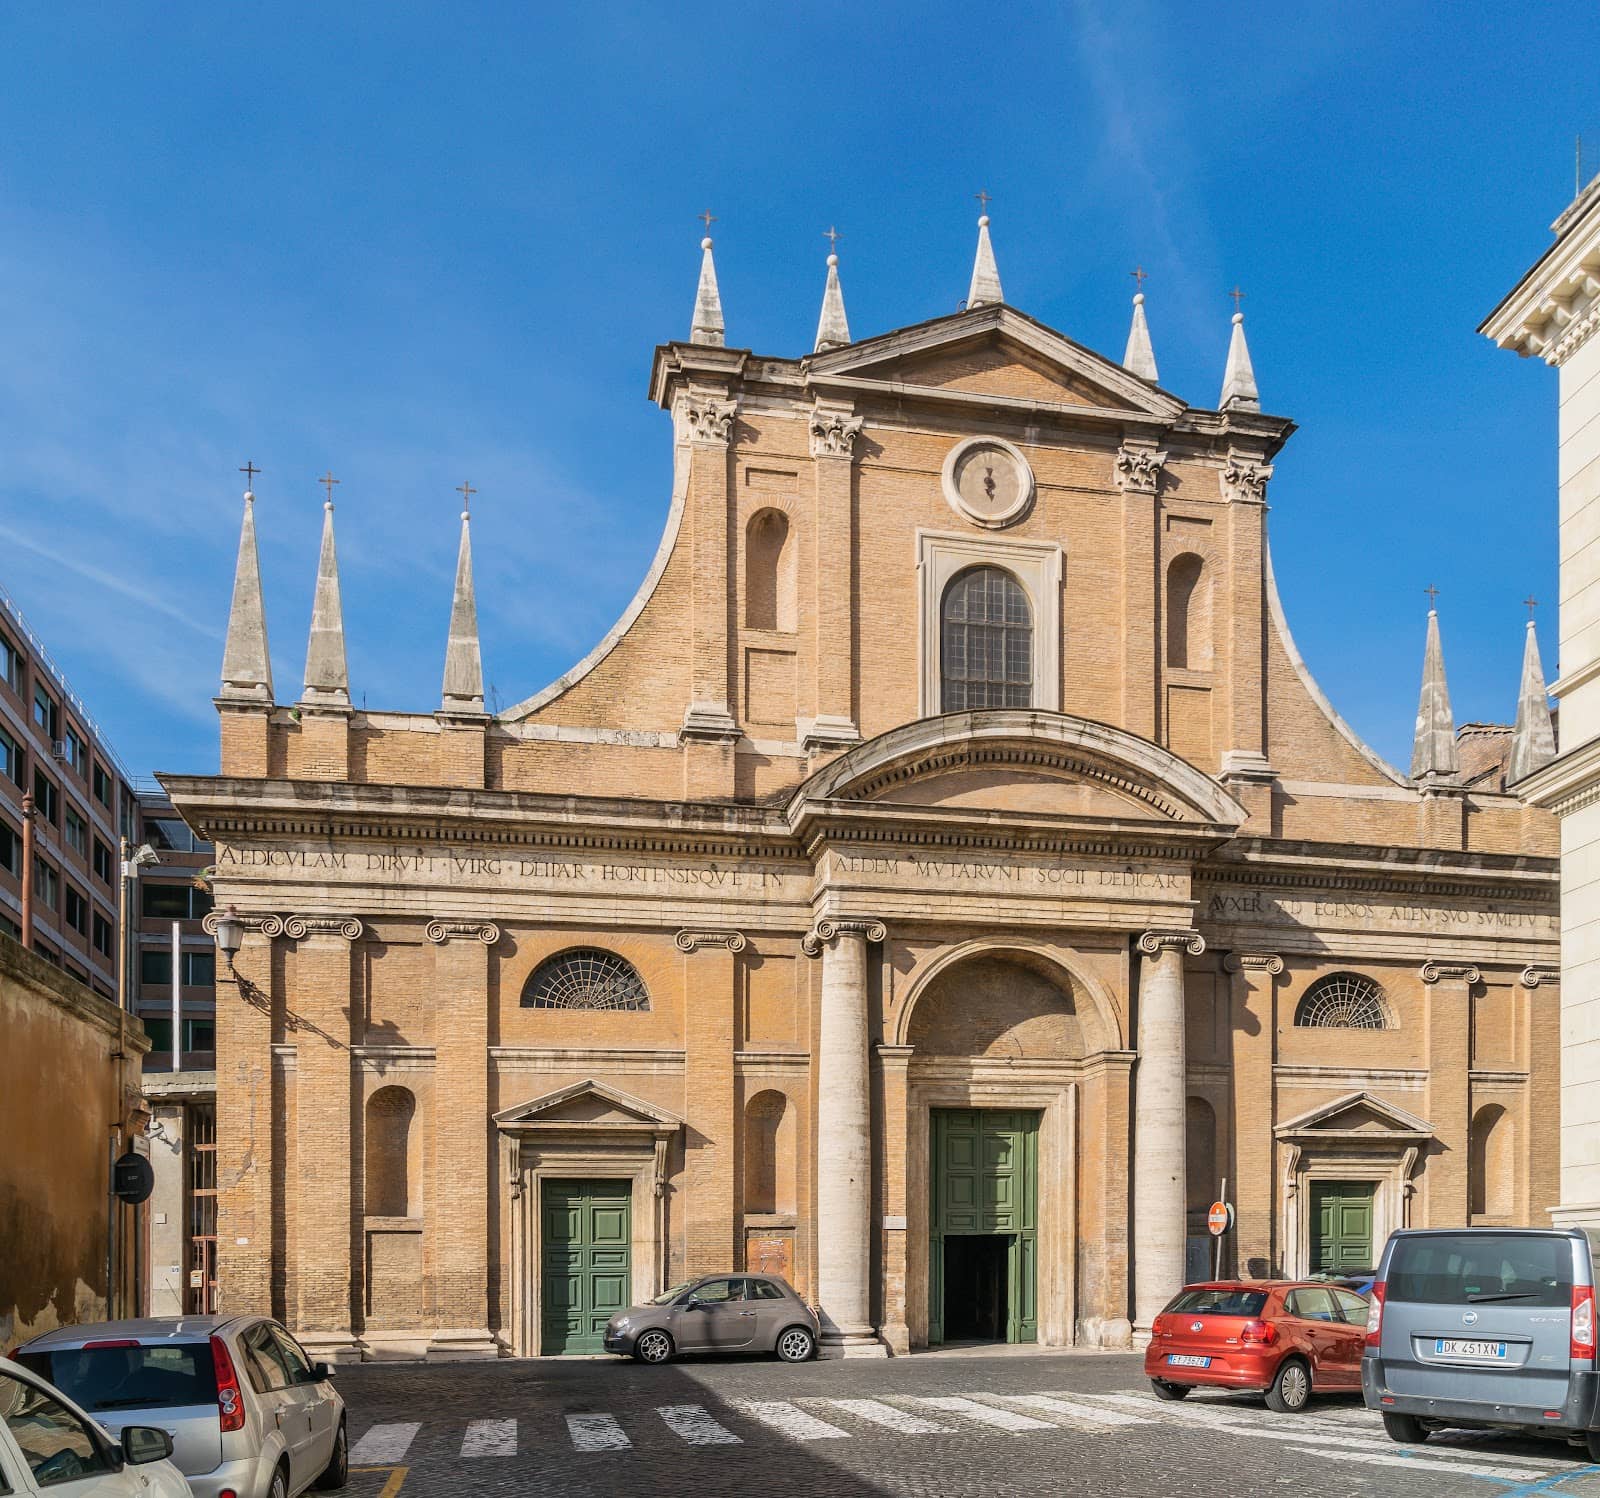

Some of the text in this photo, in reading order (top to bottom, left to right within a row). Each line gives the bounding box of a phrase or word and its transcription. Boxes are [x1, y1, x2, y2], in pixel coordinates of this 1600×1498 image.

[218, 845, 348, 869] AEDICVLAM
[455, 857, 502, 875] VIRG
[760, 872, 784, 888] IN
[834, 857, 899, 875] AEDEM
[1038, 867, 1085, 885] SOCII
[1099, 870, 1180, 889] DEDICAR
[1278, 899, 1303, 915] AD
[1314, 901, 1376, 919] EGENOS
[1440, 910, 1470, 924] SVO
[1444, 1341, 1498, 1355] DK 451XN
